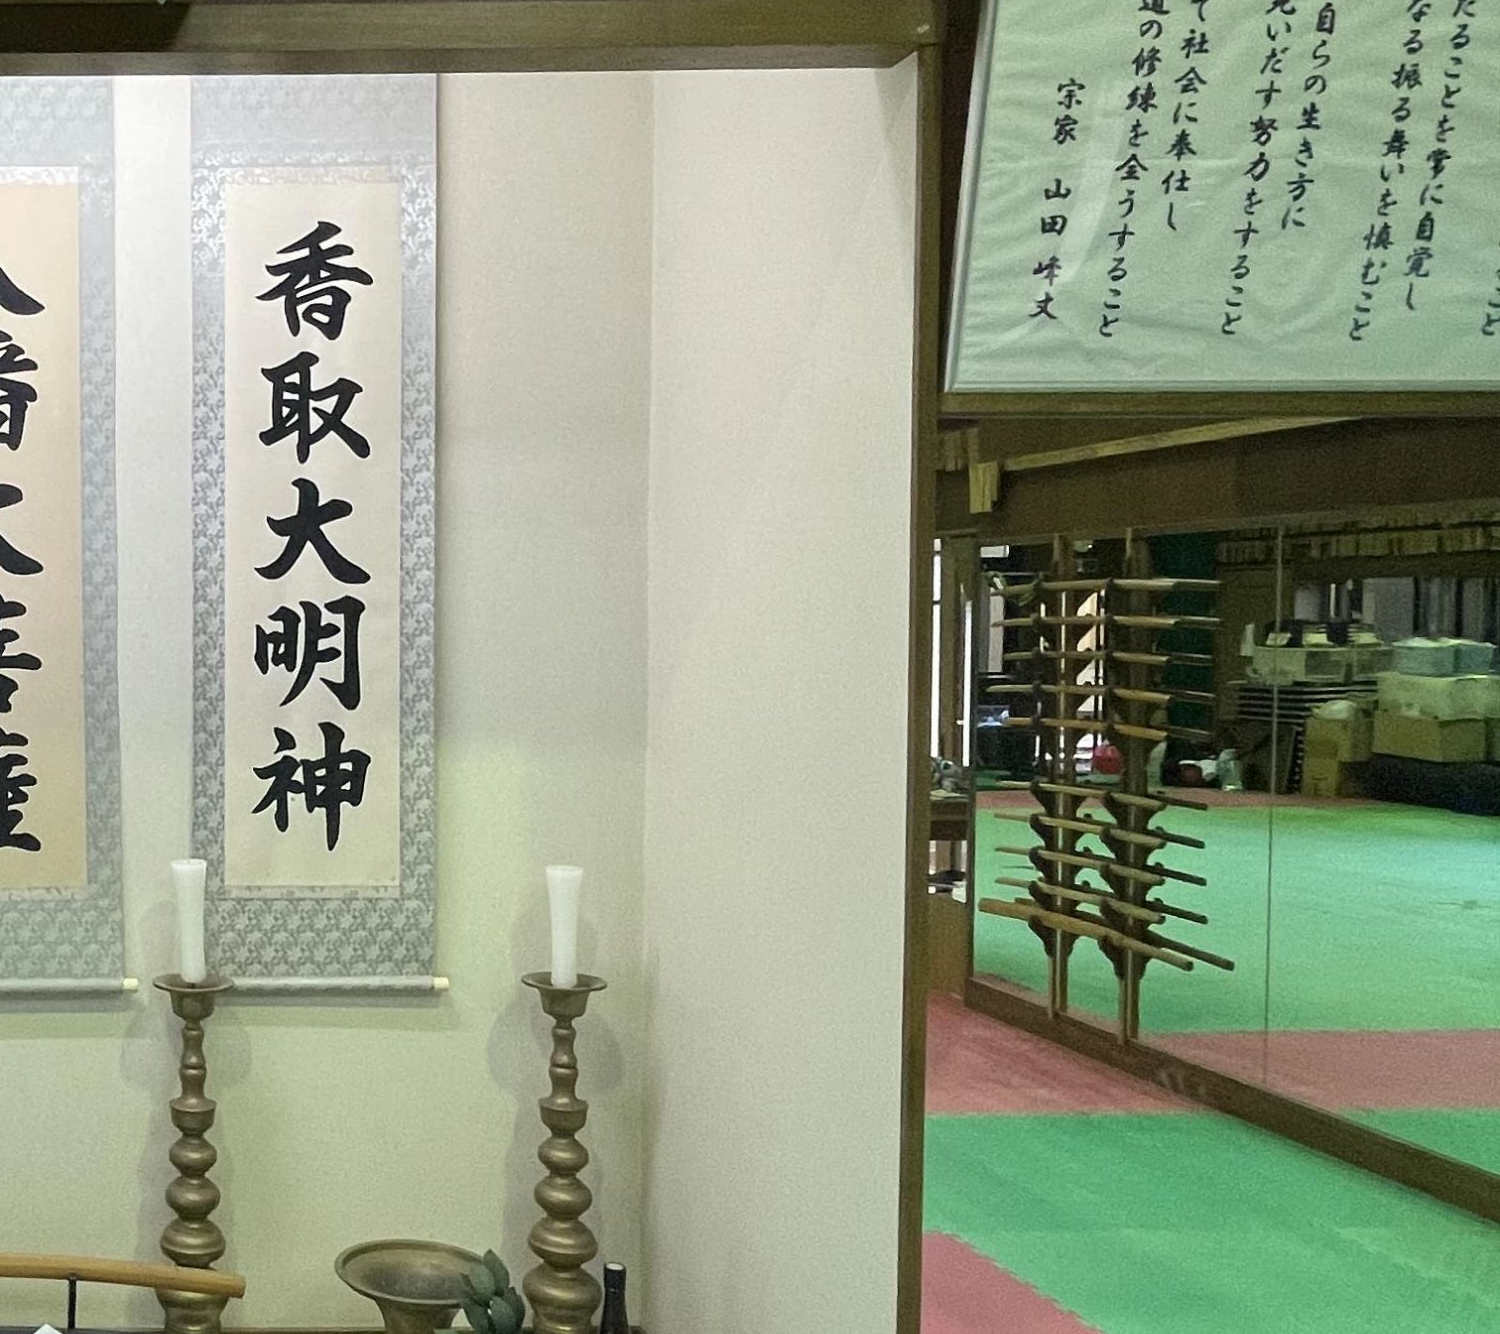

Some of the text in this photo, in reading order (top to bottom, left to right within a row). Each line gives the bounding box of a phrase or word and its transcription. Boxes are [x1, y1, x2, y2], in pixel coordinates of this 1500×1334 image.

[1052, 77, 1086, 145] 宗家
[1041, 178, 1072, 236] 山田
[251, 221, 374, 852] 香取大明神
